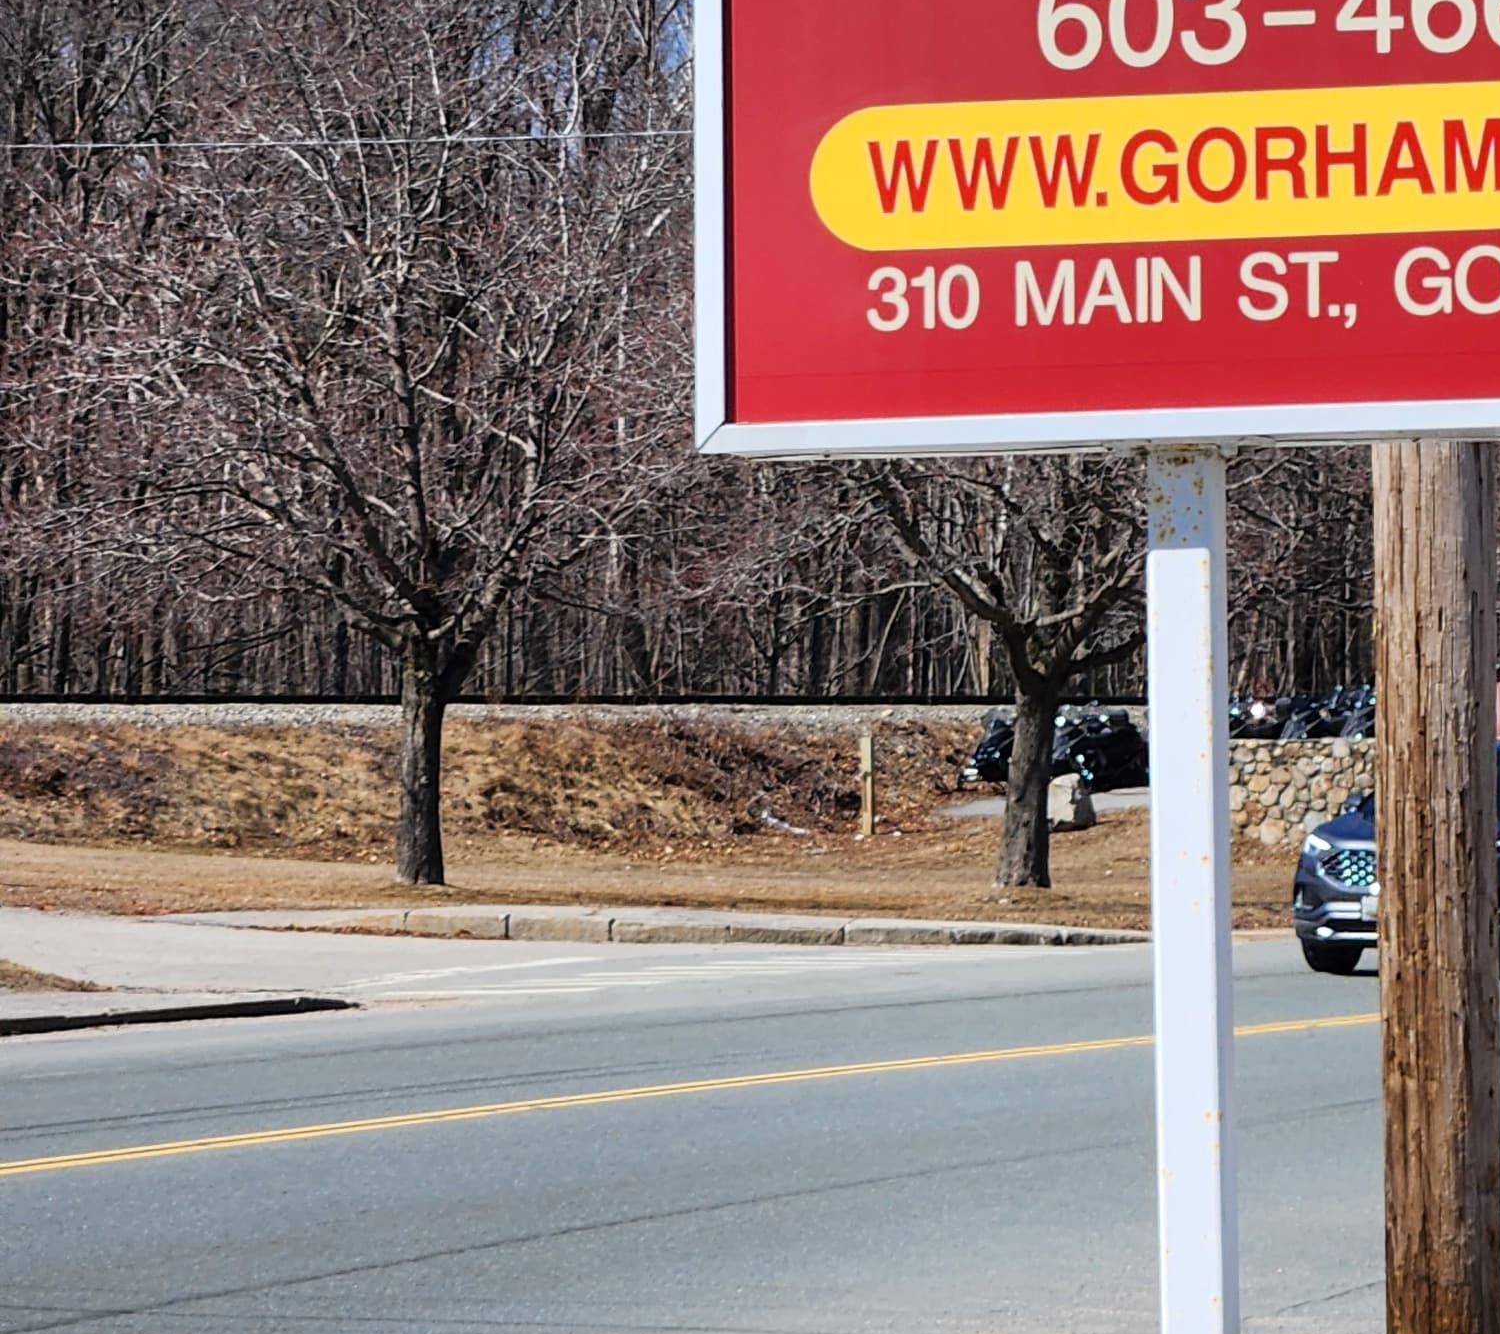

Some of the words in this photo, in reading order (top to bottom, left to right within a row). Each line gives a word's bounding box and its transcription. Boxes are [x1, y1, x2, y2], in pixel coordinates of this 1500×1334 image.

[867, 264, 981, 332] 310
[1015, 255, 1202, 327] MAIN
[1238, 251, 1357, 329] ST.,
